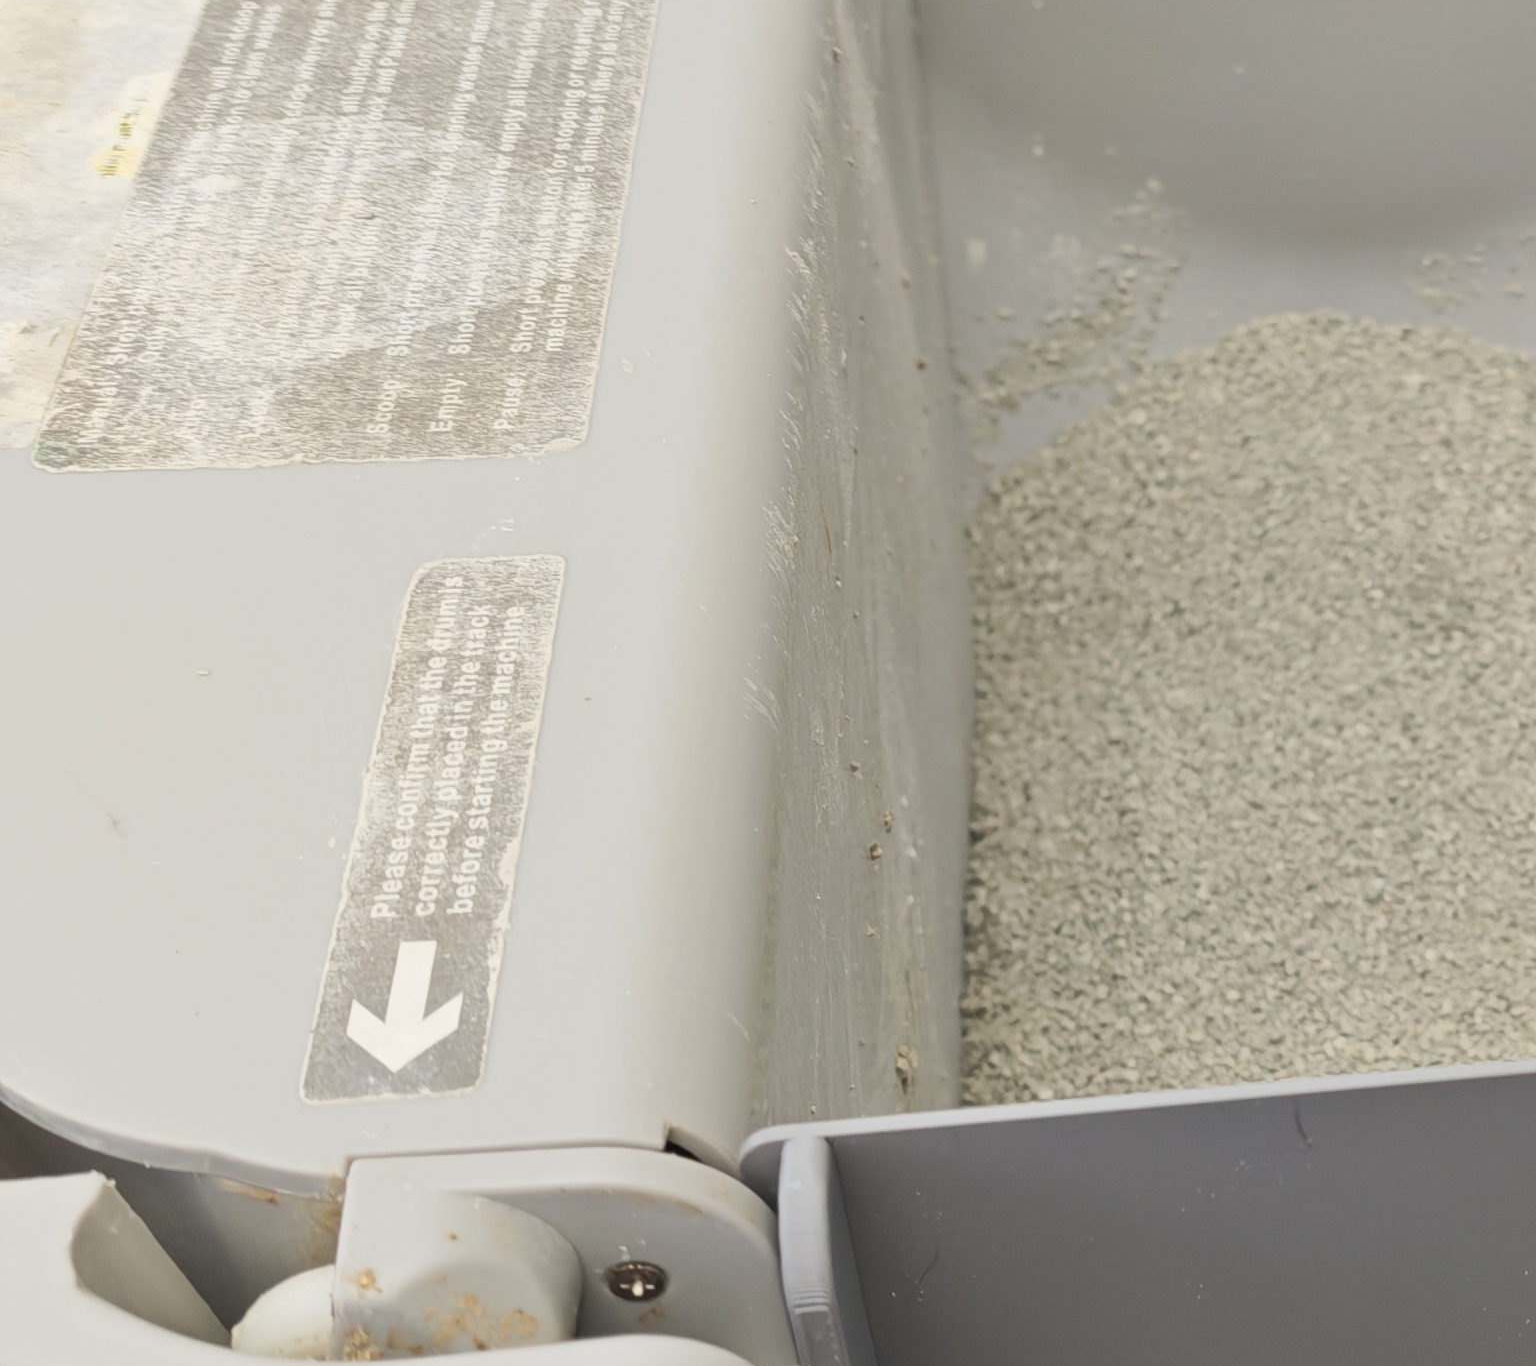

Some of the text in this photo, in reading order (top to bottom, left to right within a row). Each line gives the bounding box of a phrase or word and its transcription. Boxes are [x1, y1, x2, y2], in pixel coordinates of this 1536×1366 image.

[446, 308, 479, 354] Short
[508, 306, 540, 352] Short
[539, 283, 574, 351] machine
[372, 576, 465, 918] Please confirm that the drum is
[412, 604, 493, 916] correctly placed in the track
[449, 605, 526, 913] before starting the machine
